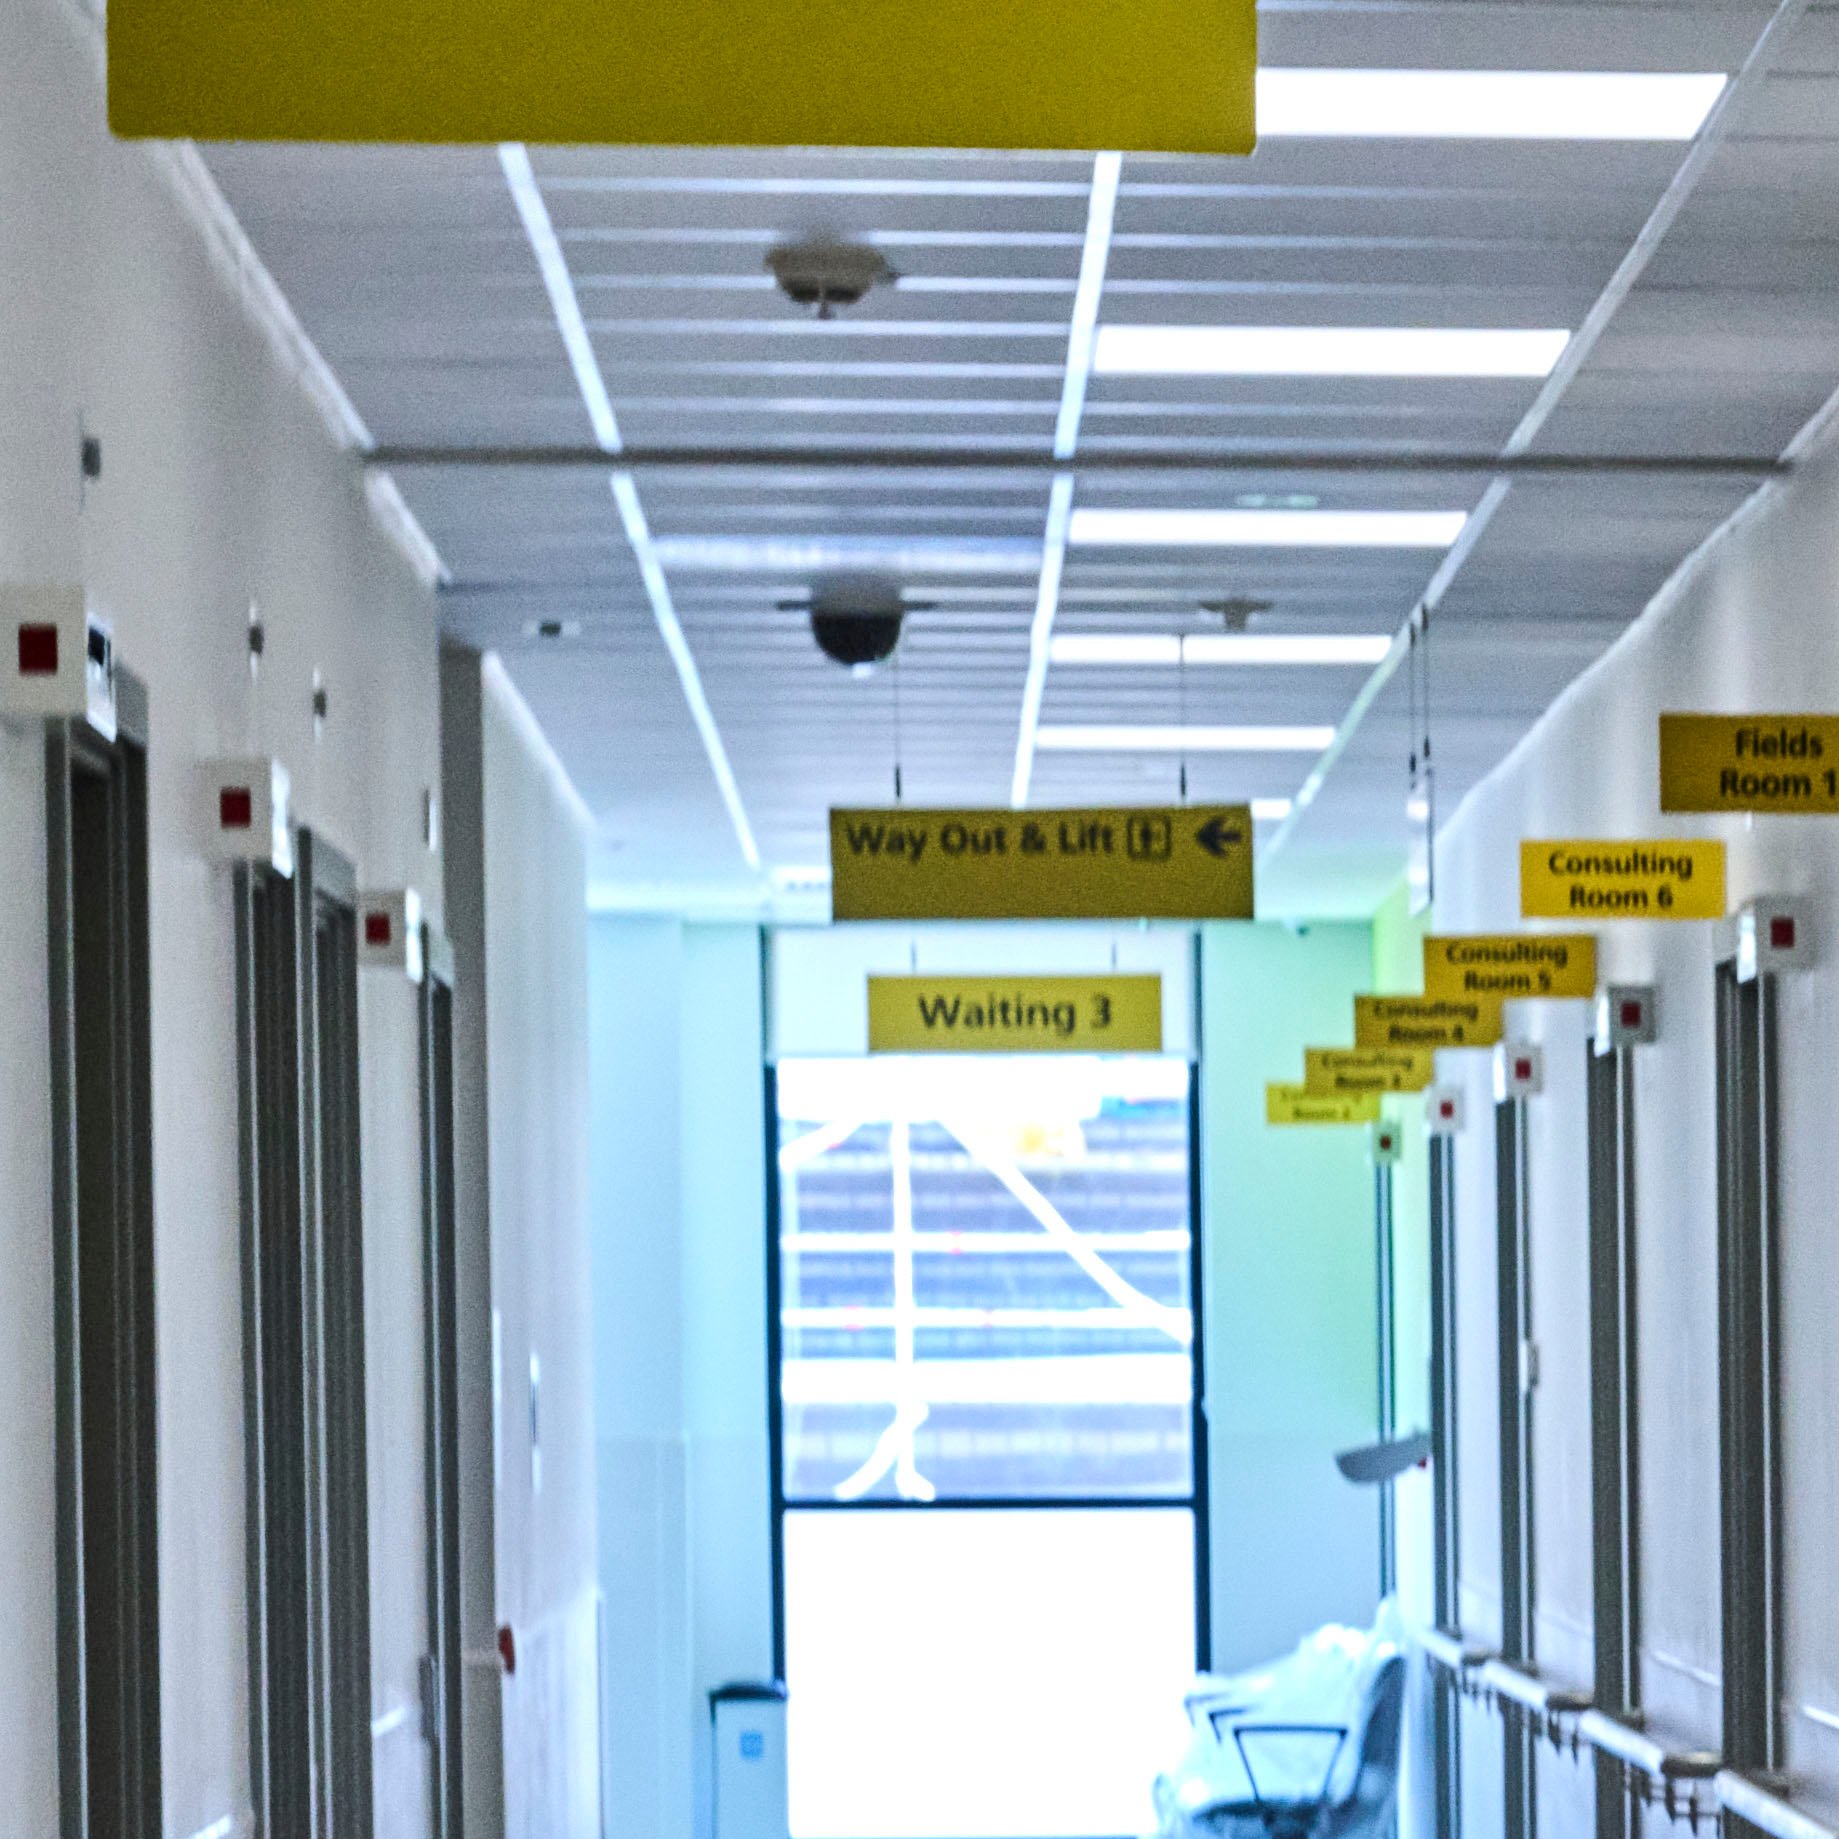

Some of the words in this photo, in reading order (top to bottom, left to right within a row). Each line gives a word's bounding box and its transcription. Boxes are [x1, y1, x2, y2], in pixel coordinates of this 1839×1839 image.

[1735, 727, 1824, 757] Fields
[1720, 769, 1811, 797] Room
[1824, 769, 1838, 797] 1
[846, 823, 927, 861] Way
[940, 823, 1006, 855] Out
[1019, 824, 1047, 855] &
[1059, 823, 1113, 855] Lift
[1549, 849, 1693, 880] Consulting
[1570, 886, 1648, 908] Room
[1658, 885, 1673, 908] 6
[1446, 942, 1568, 968] Consulting
[1465, 971, 1530, 991] Room
[918, 993, 1075, 1037] Waiting
[1092, 993, 1111, 1028] 3
